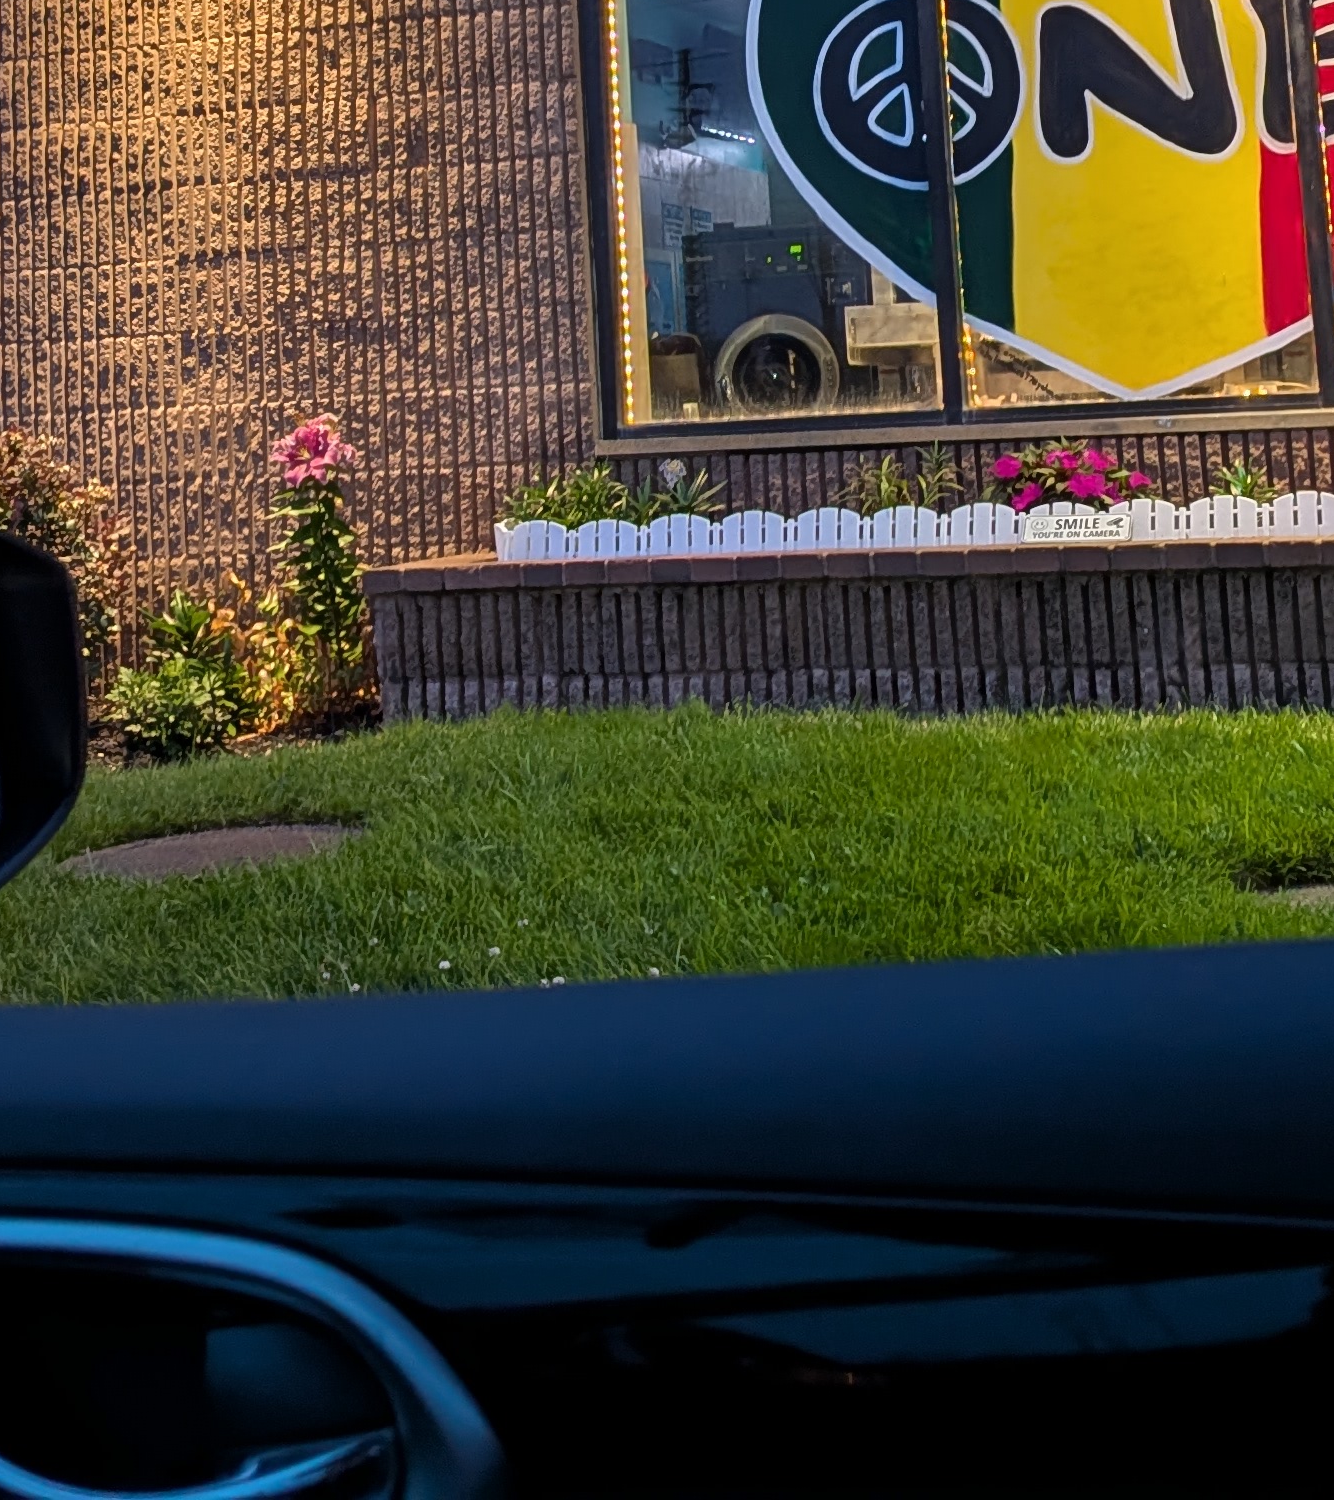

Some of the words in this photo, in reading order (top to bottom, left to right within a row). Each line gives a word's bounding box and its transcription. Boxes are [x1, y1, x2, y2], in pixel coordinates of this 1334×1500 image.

[1054, 517, 1100, 531] SMILE
[1032, 530, 1064, 539] YOU'RE
[1066, 530, 1081, 539] ON
[1083, 529, 1121, 538] CAMERA
